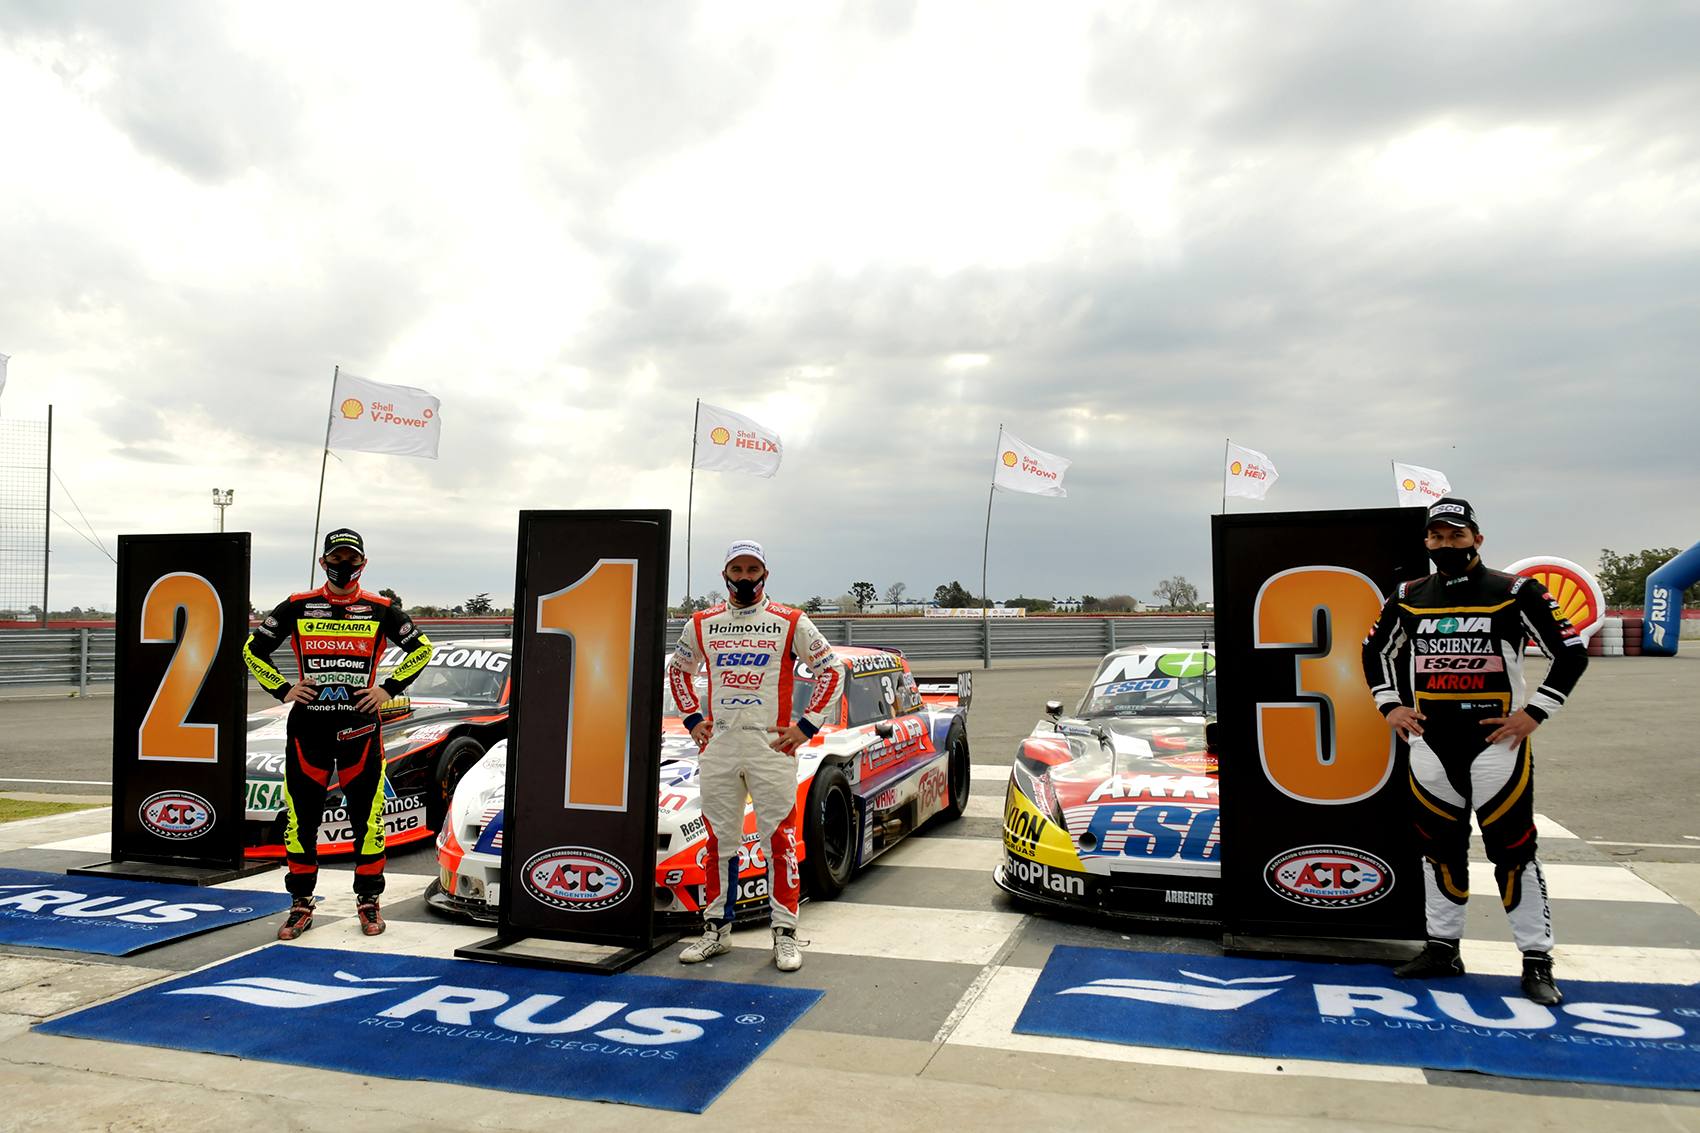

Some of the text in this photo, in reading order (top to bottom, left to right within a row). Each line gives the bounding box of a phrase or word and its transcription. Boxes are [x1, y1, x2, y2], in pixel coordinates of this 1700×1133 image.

[371, 401, 393, 411] Shell
[371, 411, 428, 428] V-Power
[737, 430, 756, 438] Shell
[736, 437, 778, 453] HELIX
[1651, 588, 1668, 621] RUS
[316, 622, 371, 632] CHICHARRA
[709, 622, 782, 634] Haimovich
[1417, 617, 1491, 634] NOVA
[305, 640, 355, 650] RIOSMA
[709, 639, 777, 651] RECYCLER
[1429, 638, 1494, 653] SCIENZA
[138, 571, 224, 763] 2
[379, 646, 511, 672] LIGONG
[716, 653, 770, 667] ESCO
[1424, 657, 1488, 670] ESCO
[536, 559, 638, 812] 1
[720, 671, 766, 685] Fadel
[1253, 565, 1397, 805] 3
[1427, 674, 1485, 689] AKRON
[881, 675, 895, 705] 3
[1103, 679, 1171, 695] ESCO
[156, 803, 196, 825] ACTC
[324, 815, 418, 842] vonte
[1078, 805, 1221, 862] ESC
[545, 863, 604, 892] ACTC
[665, 869, 683, 885] 3
[1293, 862, 1361, 889] ACTC
[553, 889, 599, 898] ARGENTINA
[1165, 890, 1214, 906] ARRECIFES
[1303, 887, 1355, 896] ARGENTINA
[0, 889, 225, 924] RUS
[375, 984, 724, 1045] RUS
[1312, 983, 1686, 1039] RUS
[1320, 1016, 1371, 1027] RIO
[1384, 1021, 1537, 1040] URUGUAY
[358, 1017, 679, 1060] RIO URUGUAY SEGUROS
